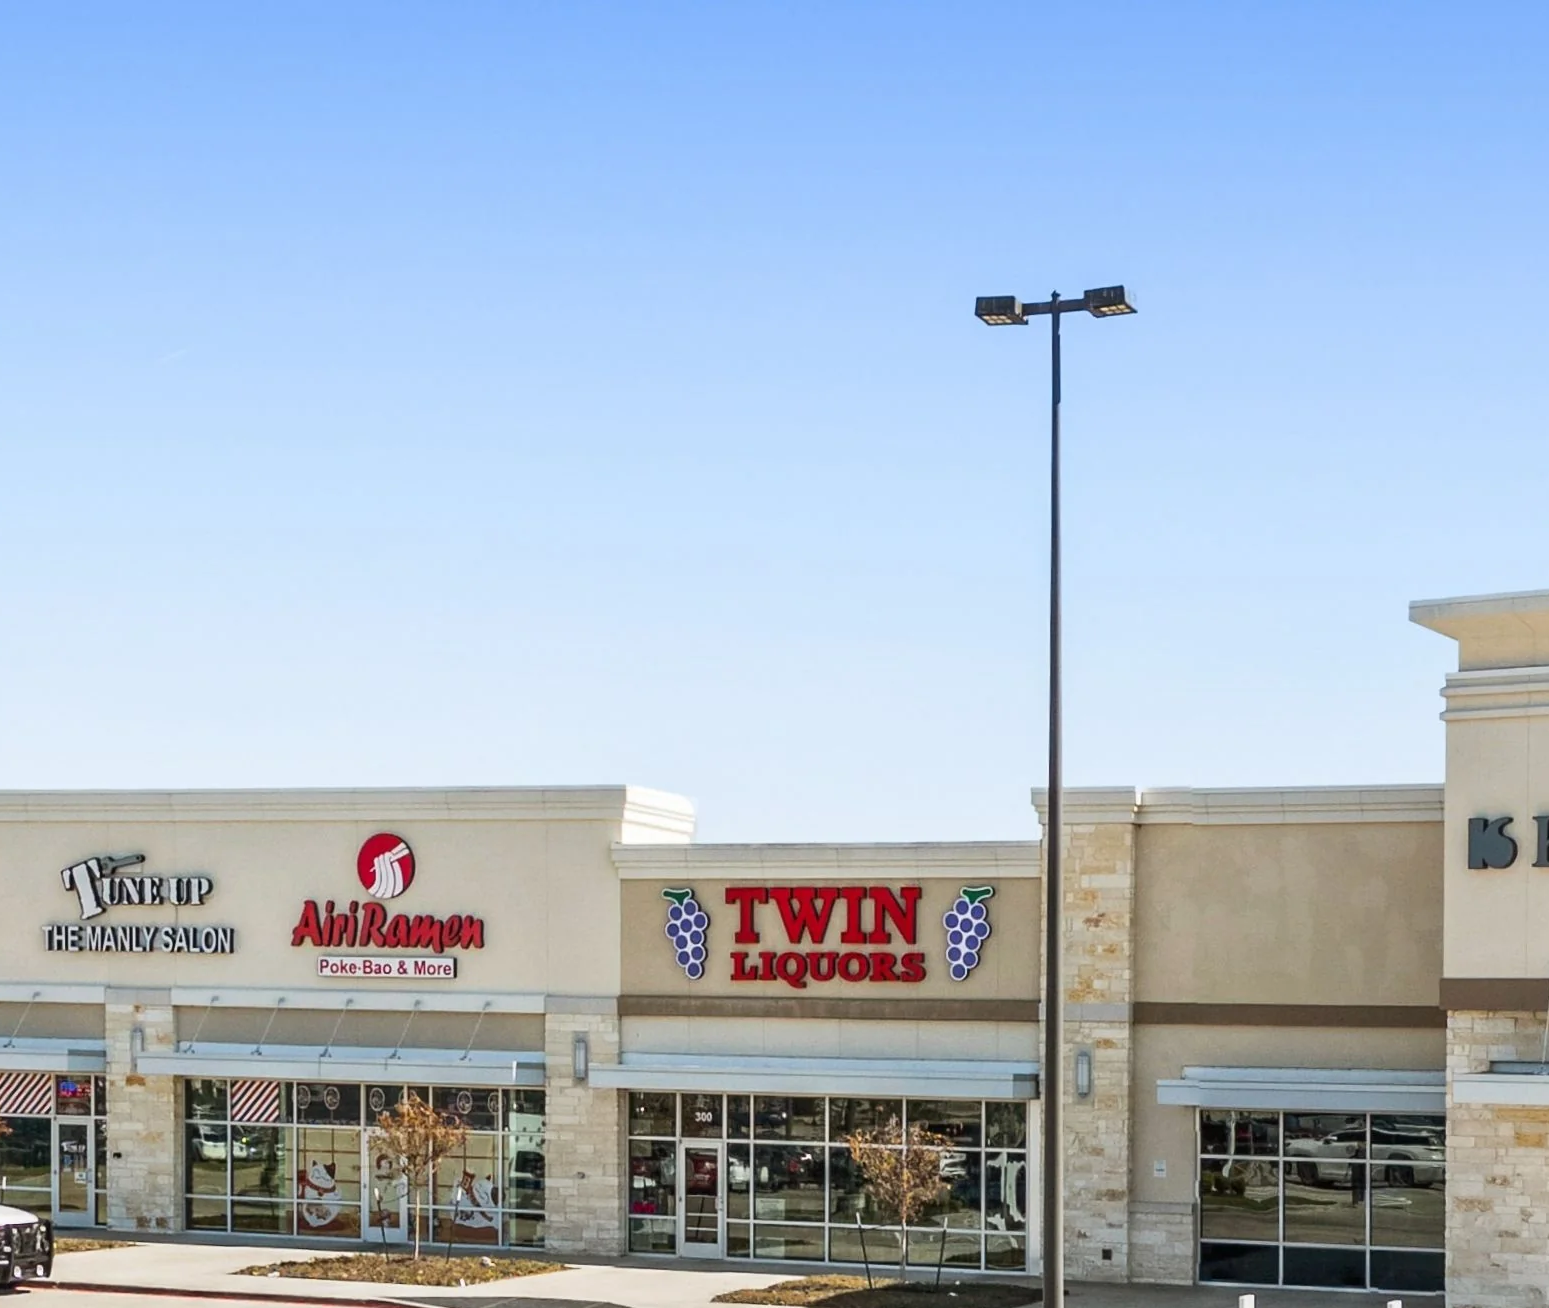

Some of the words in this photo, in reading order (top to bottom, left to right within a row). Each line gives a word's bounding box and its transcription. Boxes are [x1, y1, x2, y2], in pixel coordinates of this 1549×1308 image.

[60, 856, 164, 921] TUNE
[167, 876, 214, 905] UP
[291, 900, 359, 947] Airi
[359, 902, 485, 954] Ramen
[725, 887, 923, 945] TWIN
[41, 926, 83, 952] THE
[86, 926, 158, 952] MANLY
[161, 927, 235, 954] SALON
[397, 960, 408, 975] &
[414, 960, 452, 976] More
[730, 952, 927, 988] LIQUORS
[694, 1111, 713, 1122] 300
